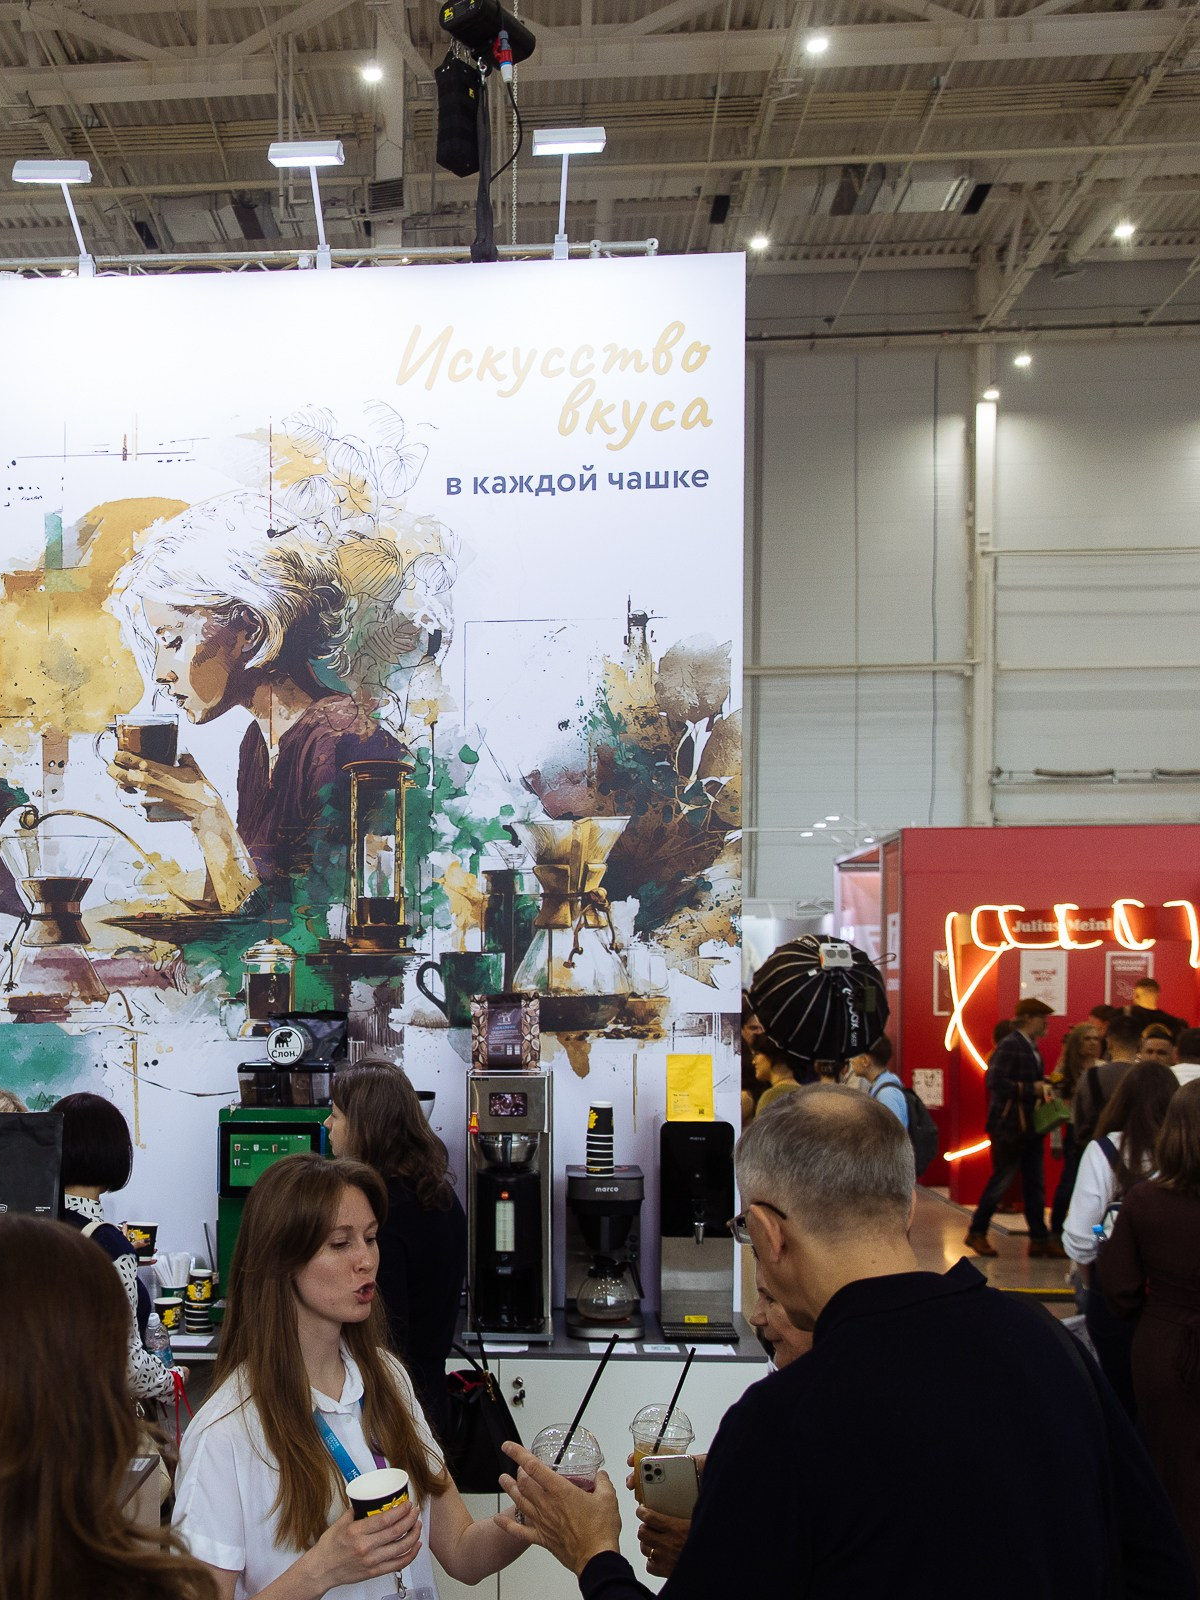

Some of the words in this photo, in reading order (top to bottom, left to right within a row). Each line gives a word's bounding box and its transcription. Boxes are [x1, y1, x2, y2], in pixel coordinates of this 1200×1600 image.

[395, 320, 712, 399] Искусство
[557, 378, 714, 452] вкуса
[445, 477, 462, 496] в
[472, 464, 598, 497] каждой
[607, 468, 710, 491] чашке
